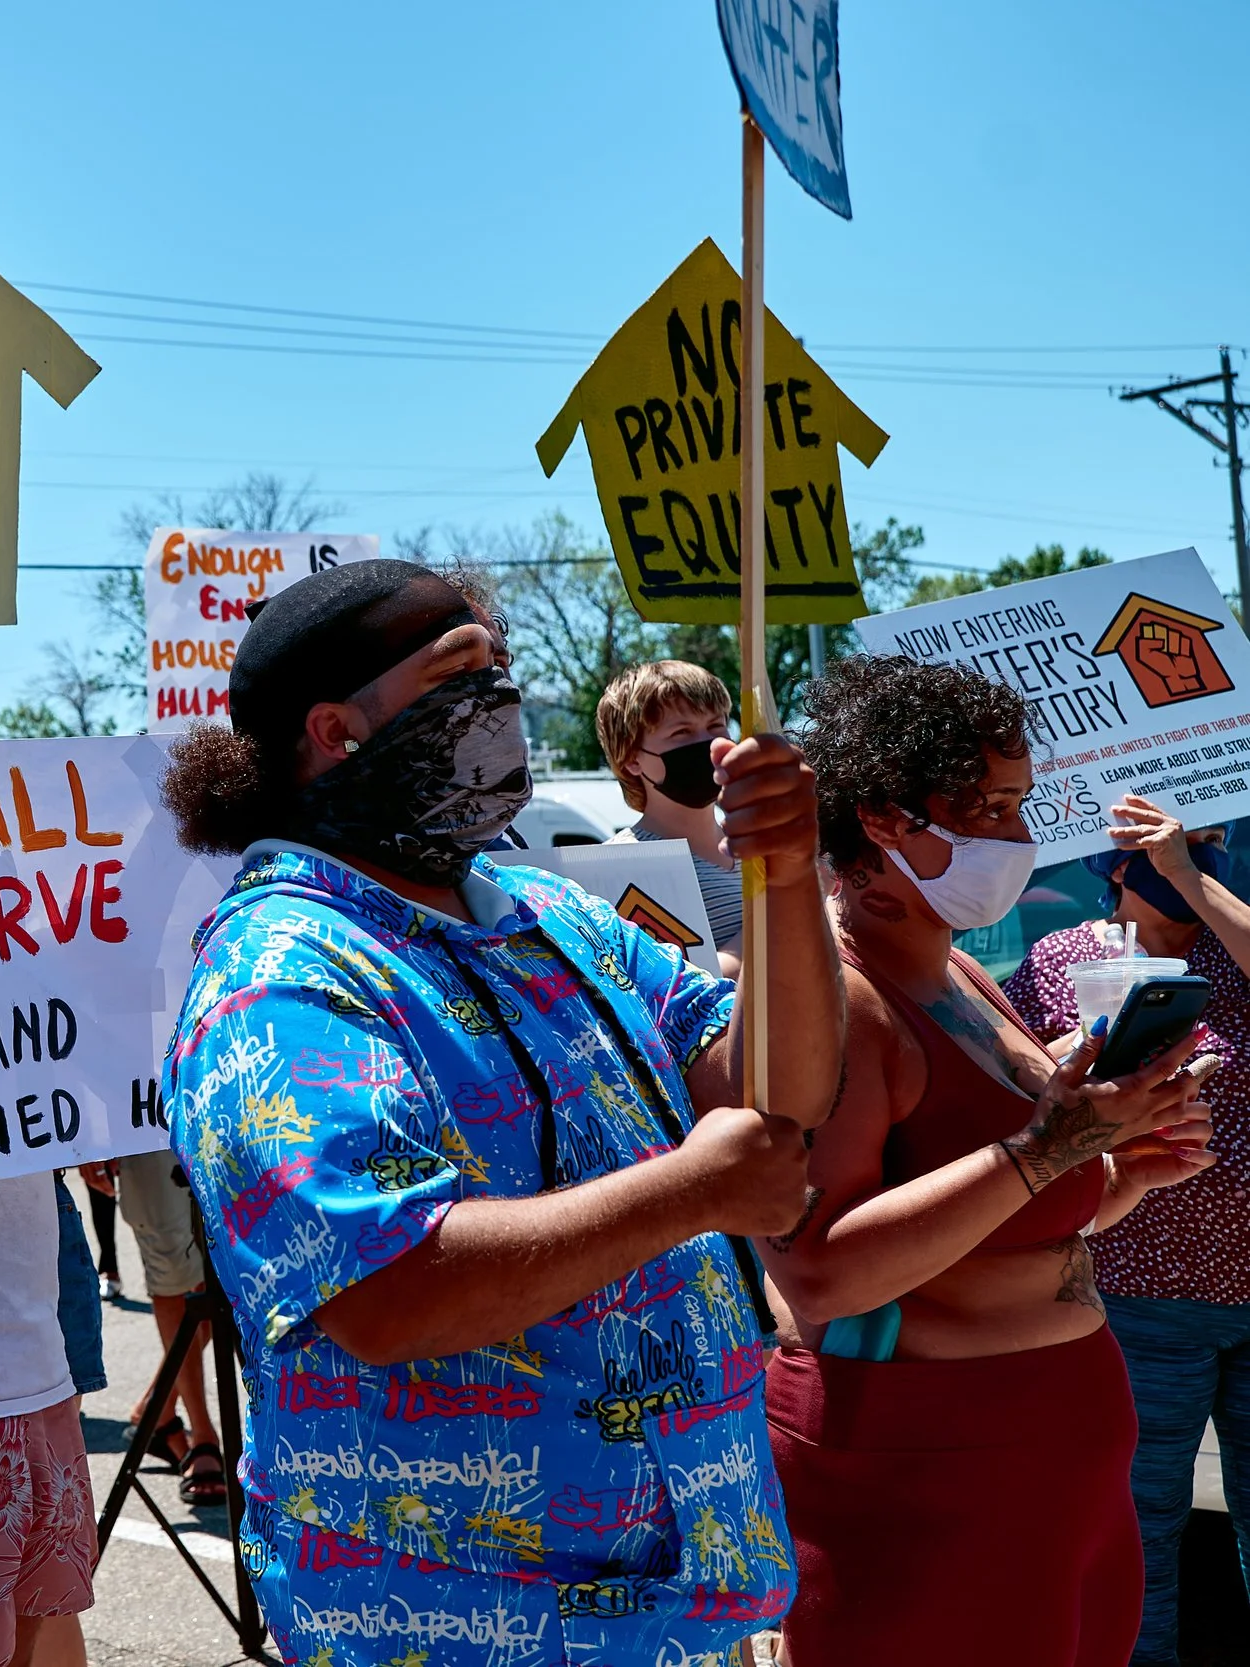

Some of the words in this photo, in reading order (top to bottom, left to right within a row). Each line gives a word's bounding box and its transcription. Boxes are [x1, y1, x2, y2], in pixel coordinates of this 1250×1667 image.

[614, 377, 821, 481] PRIVTE
[309, 544, 339, 574] IS
[894, 624, 951, 660] NOW
[952, 599, 1066, 649] ENTERING
[1056, 749, 1100, 769] BUILDING
[1100, 745, 1119, 759] ARE
[1118, 737, 1152, 754] UNITED
[1150, 734, 1166, 747] TO
[1165, 727, 1192, 743] FIGHT
[1191, 723, 1212, 737] FOR
[1210, 717, 1238, 732] THEIR
[1100, 764, 1136, 784] LEARN
[1135, 758, 1167, 776] MORE
[1166, 749, 1202, 769] ABOUT
[1201, 743, 1226, 760] OUR
[1175, 778, 1248, 806] 612-605-1888
[1034, 816, 1111, 845] JUSTICIA
